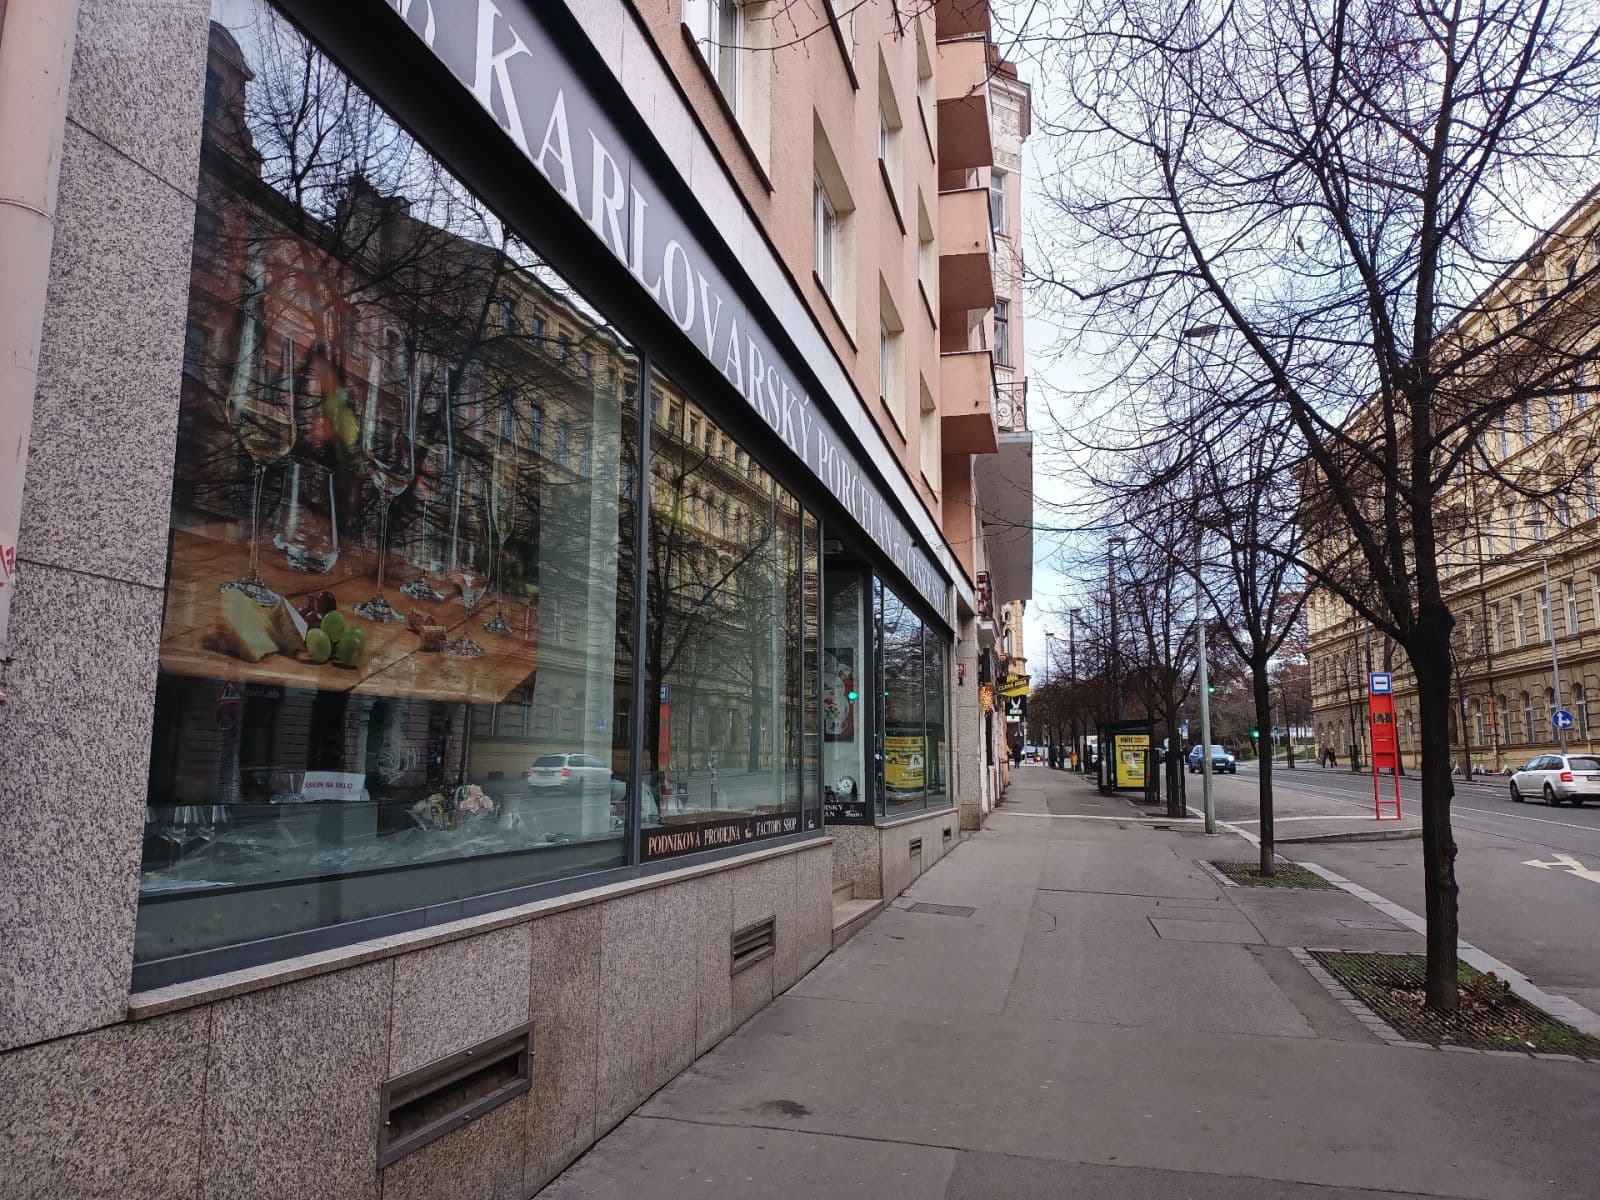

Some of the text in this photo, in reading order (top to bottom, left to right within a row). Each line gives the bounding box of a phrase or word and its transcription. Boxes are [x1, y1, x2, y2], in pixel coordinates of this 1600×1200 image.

[466, 0, 813, 464] KARLOVARSKÝ
[817, 427, 893, 557] PORCELÁN
[648, 817, 797, 856] PODNIKOVÁ PRODEJNA FACTORY SHOP
